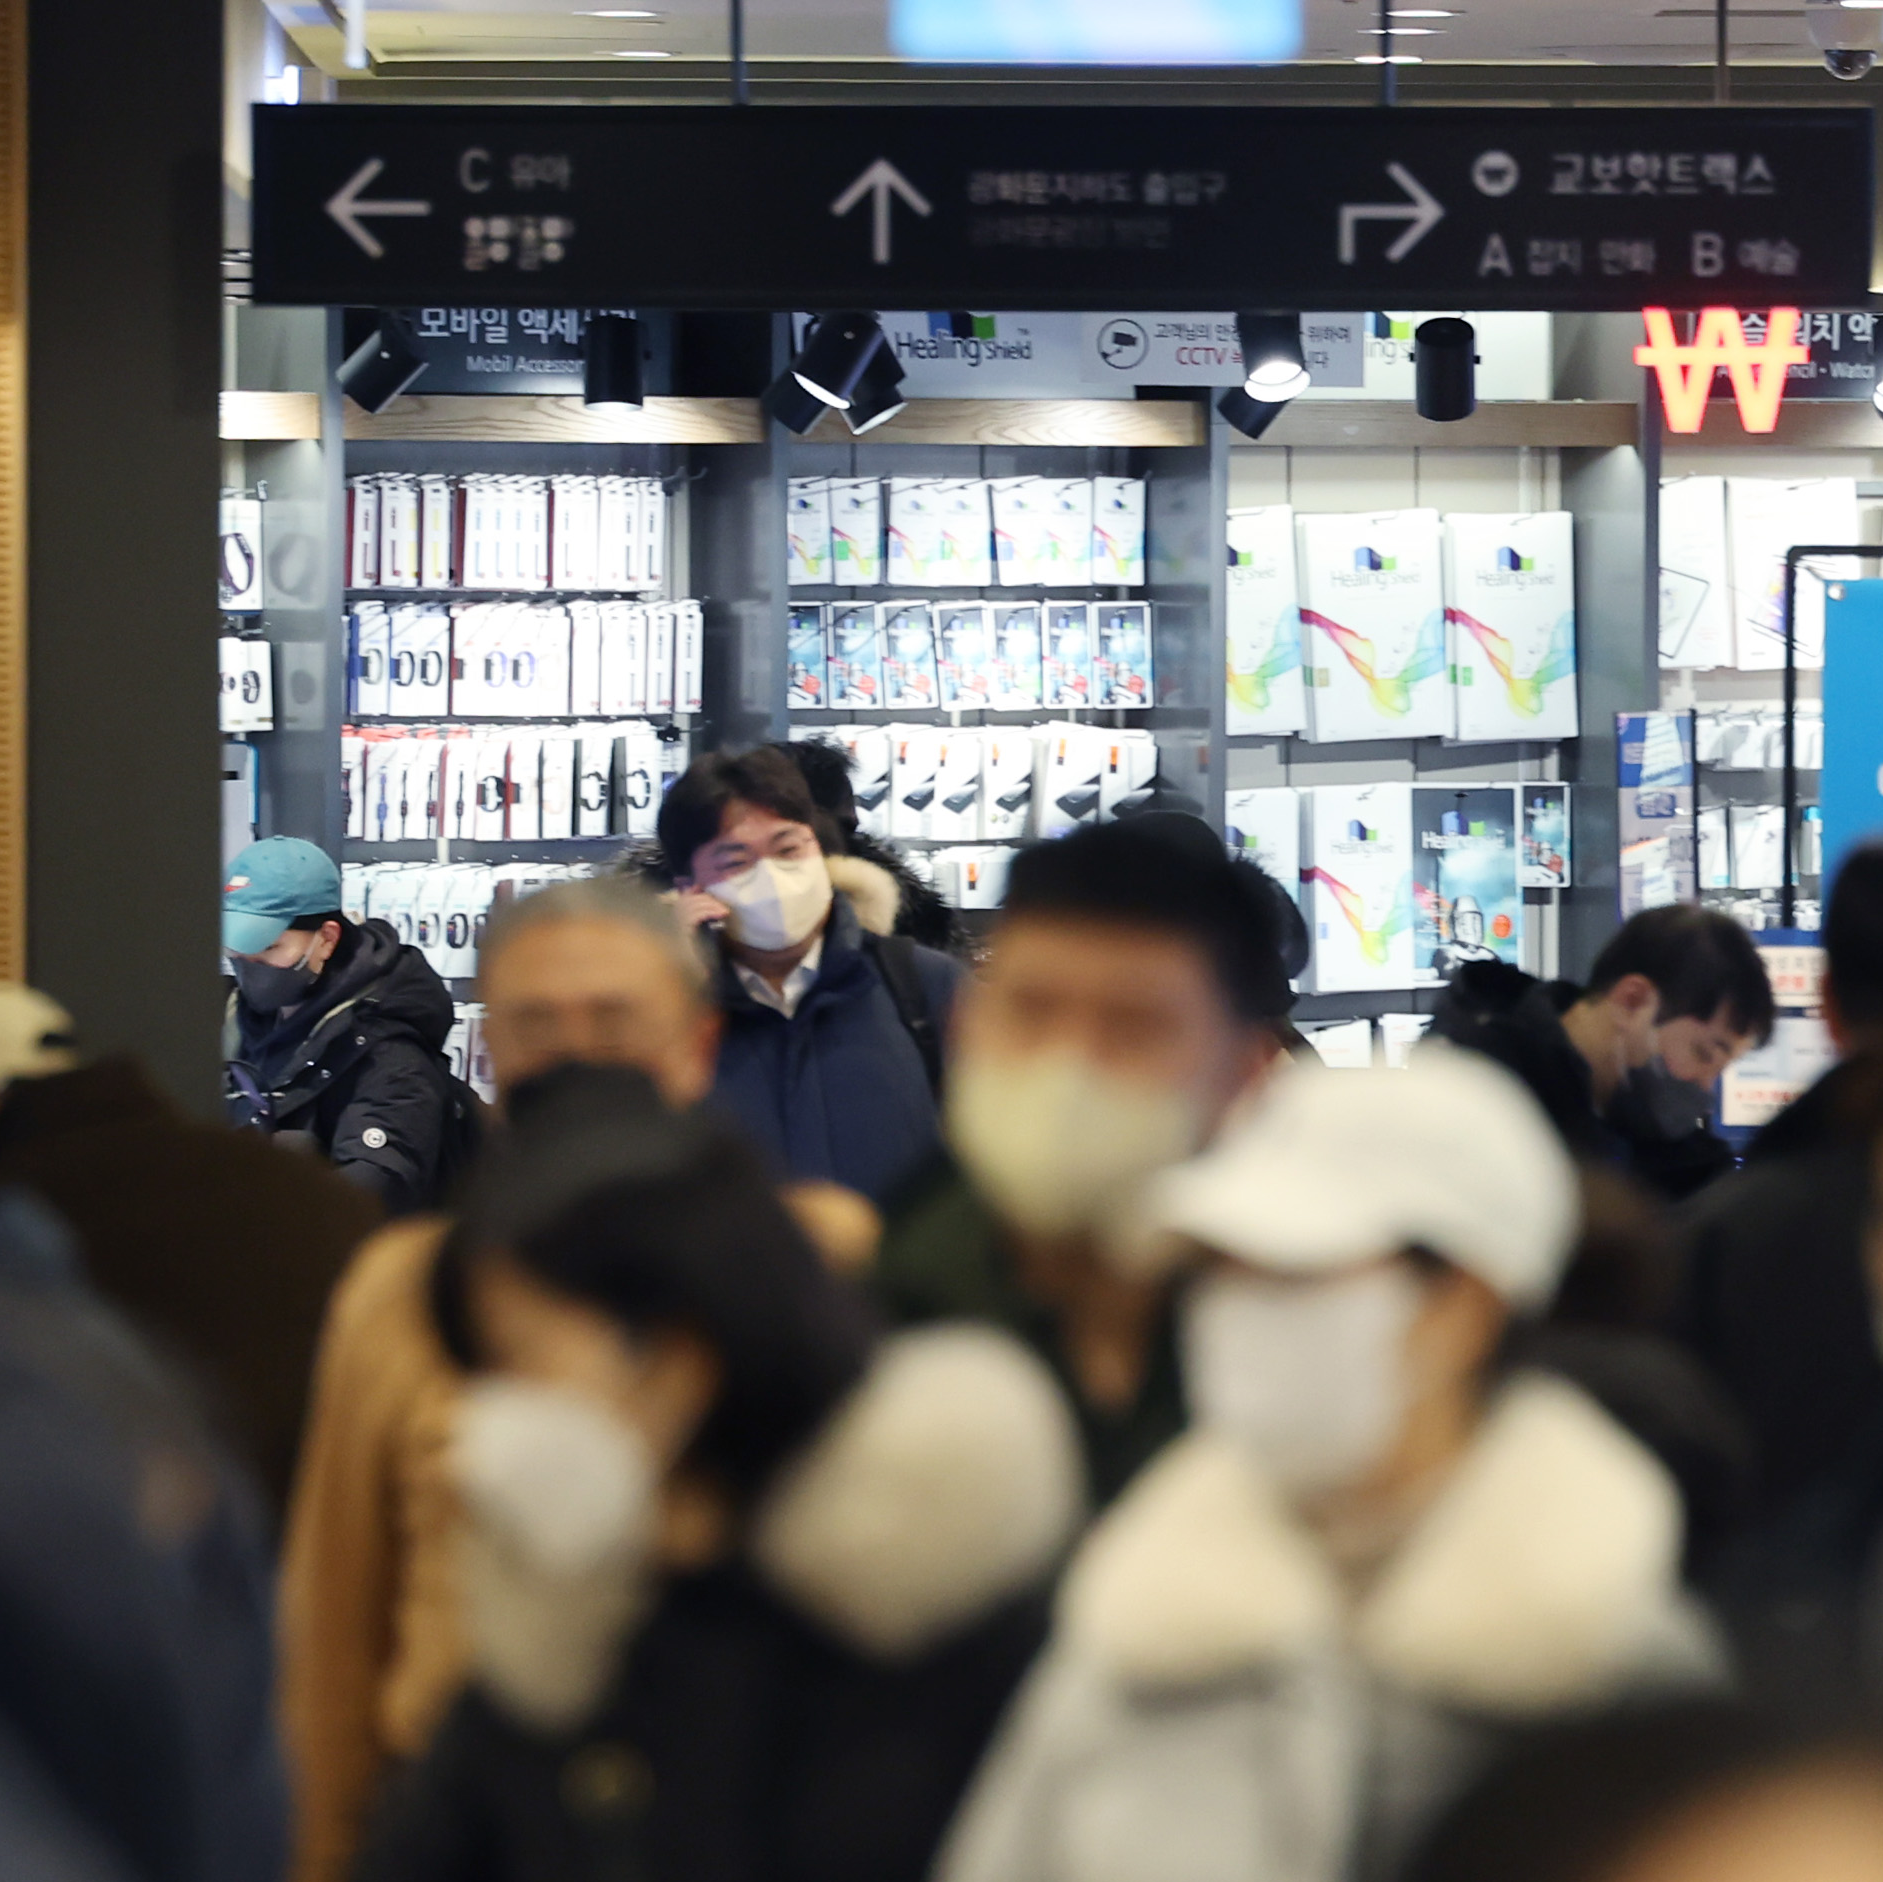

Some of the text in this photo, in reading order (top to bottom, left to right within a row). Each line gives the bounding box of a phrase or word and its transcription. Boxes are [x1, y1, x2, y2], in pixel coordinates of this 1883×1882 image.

[460, 149, 491, 193] C
[1548, 152, 1776, 195] 교보핫트랙스
[1477, 232, 1514, 277] A
[1691, 231, 1724, 278] B
[418, 308, 637, 344] 모바일 액세
[514, 356, 584, 373] Accessor
[894, 330, 1033, 366] Healing Shield
[1175, 346, 1227, 366] CCTV
